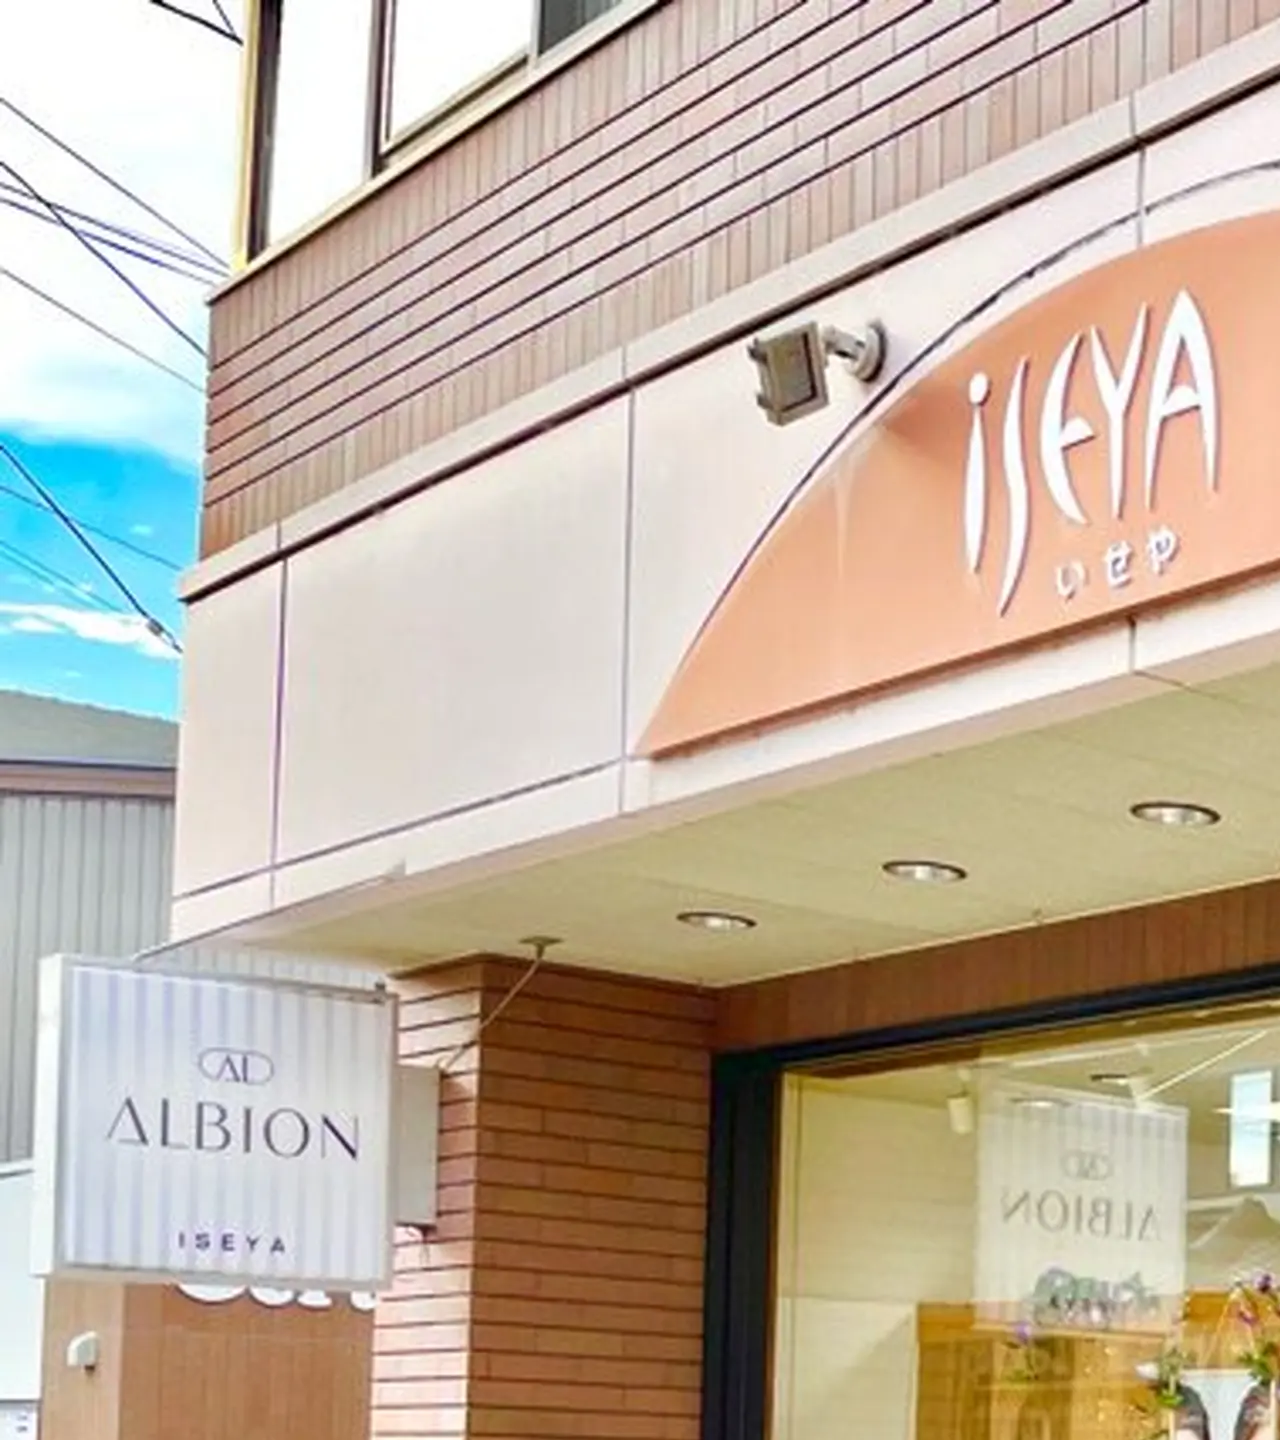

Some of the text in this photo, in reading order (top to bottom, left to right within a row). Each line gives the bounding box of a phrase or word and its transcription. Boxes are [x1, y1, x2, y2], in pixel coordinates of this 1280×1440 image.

[1054, 525, 1181, 598] いせや
[106, 1097, 360, 1162] ALBION
[178, 1230, 287, 1255] ISEYA
